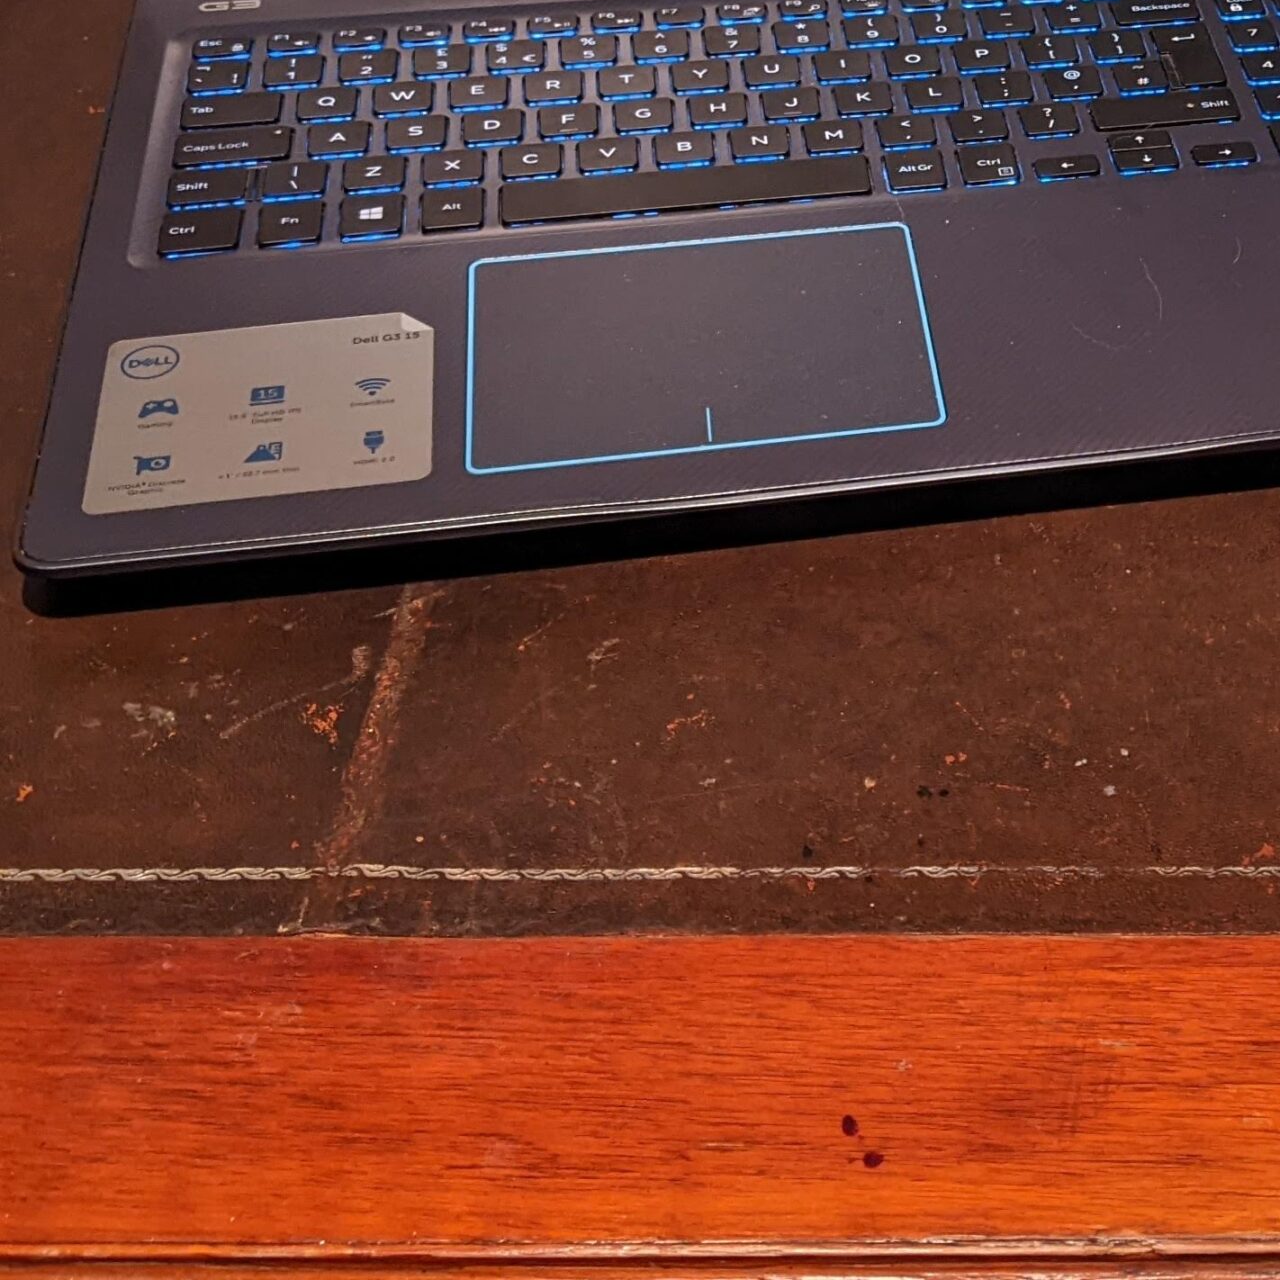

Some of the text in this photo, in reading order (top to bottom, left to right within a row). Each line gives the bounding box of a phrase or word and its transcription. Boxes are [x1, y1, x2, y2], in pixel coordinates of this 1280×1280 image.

[1131, 1, 1190, 13] Backspace
[189, 106, 215, 115] Tab
[182, 139, 250, 155] Caps Lock
[175, 180, 209, 192] Shift
[352, 330, 421, 346] Dell G3 15
[127, 355, 174, 371] DELL
